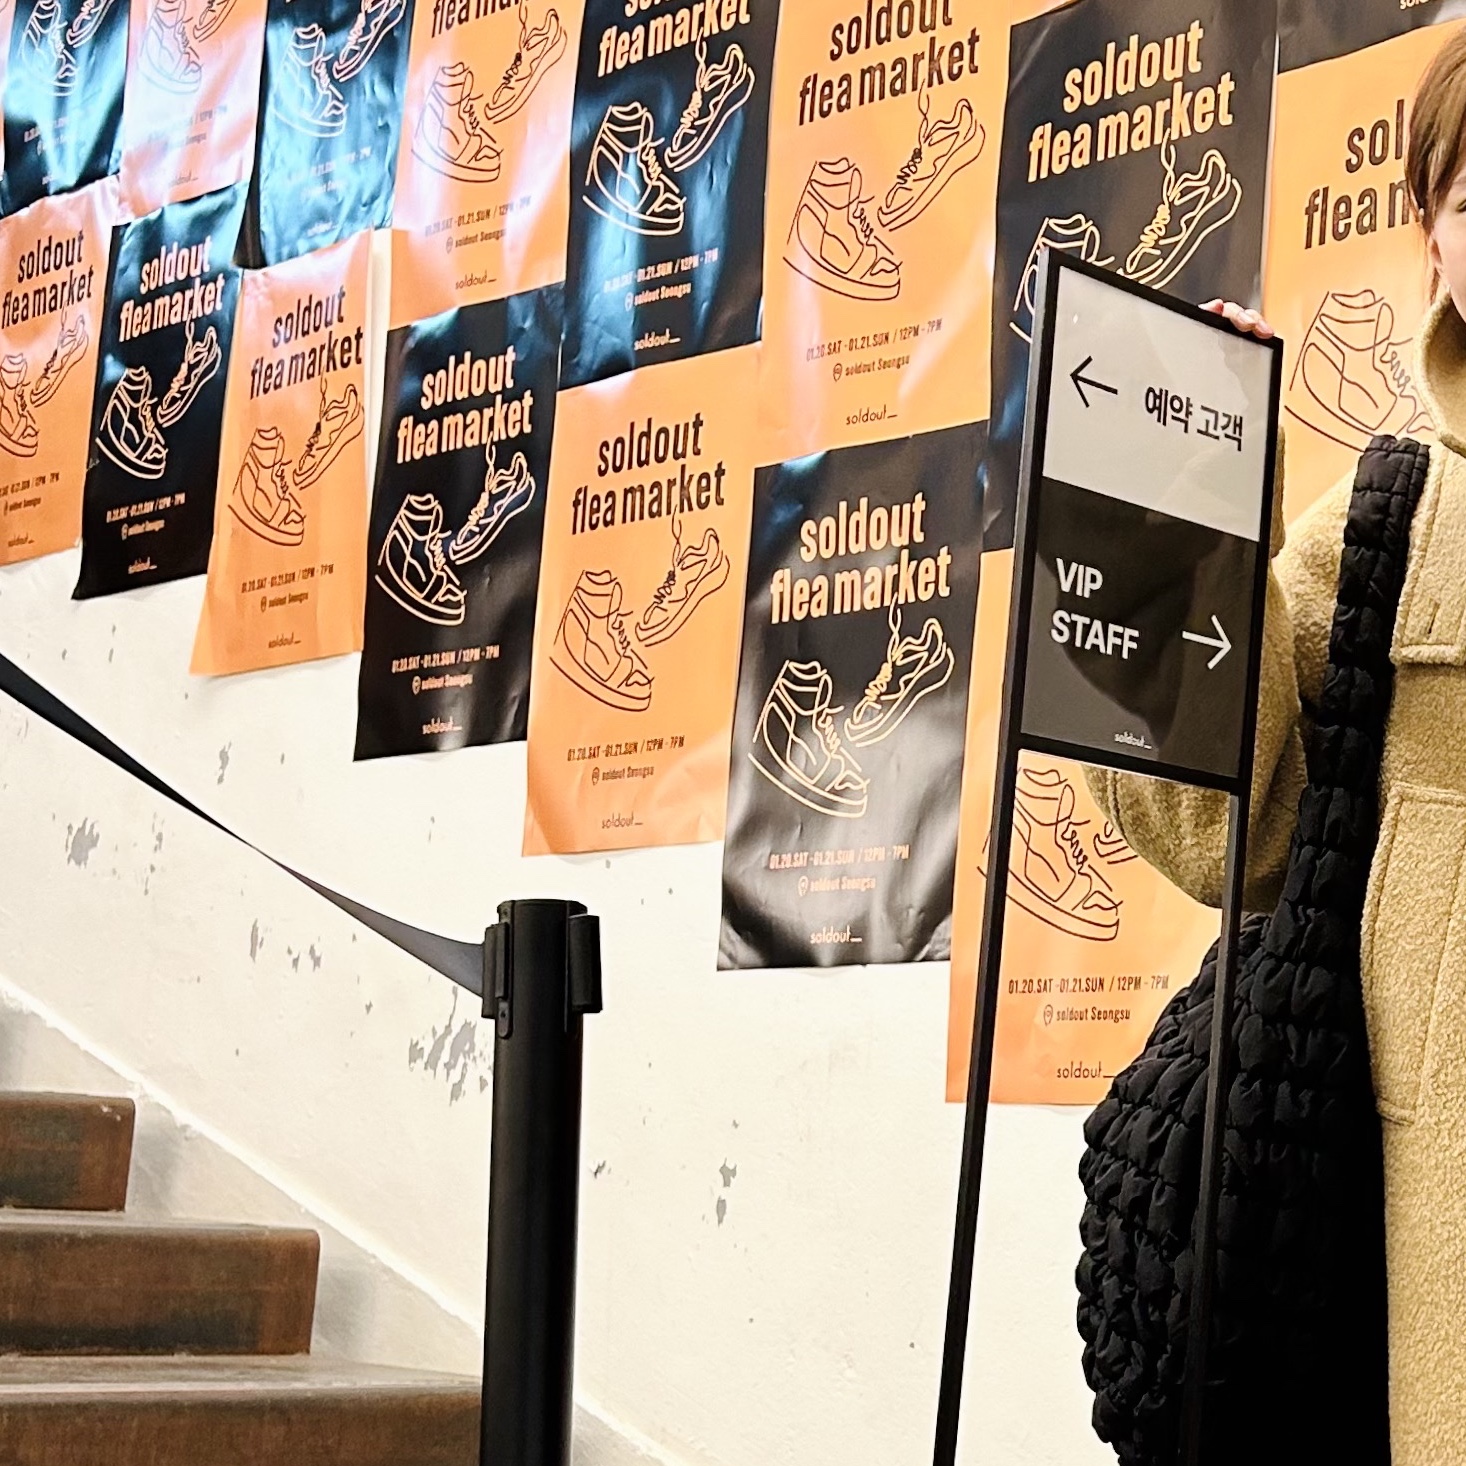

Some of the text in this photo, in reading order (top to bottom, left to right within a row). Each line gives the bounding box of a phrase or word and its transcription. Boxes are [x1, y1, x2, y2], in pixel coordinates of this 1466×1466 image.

[598, 25, 645, 78] flea
[799, 27, 980, 126] flea market
[1063, 19, 1204, 113] soldout
[1028, 72, 1235, 183] flea market
[18, 230, 84, 284] soldout
[140, 235, 212, 295] soldout
[32, 264, 94, 318] market
[152, 273, 226, 331] market
[273, 285, 346, 349] soldout
[287, 326, 363, 387] market
[421, 345, 516, 410] soldout
[396, 389, 534, 464] flea market
[597, 412, 704, 477] soldout
[1145, 386, 1243, 452] 예약 고객
[572, 461, 726, 535] flea market
[800, 491, 926, 562] soldout
[770, 545, 952, 625] flea market
[1056, 557, 1104, 599] VIP
[1050, 609, 1140, 660] STAFF
[1008, 979, 1053, 994] 01.20.SAT
[1117, 976, 1142, 992] 12PM
[1151, 974, 1170, 990] 7PM
[1090, 1006, 1131, 1024] Seongsu
